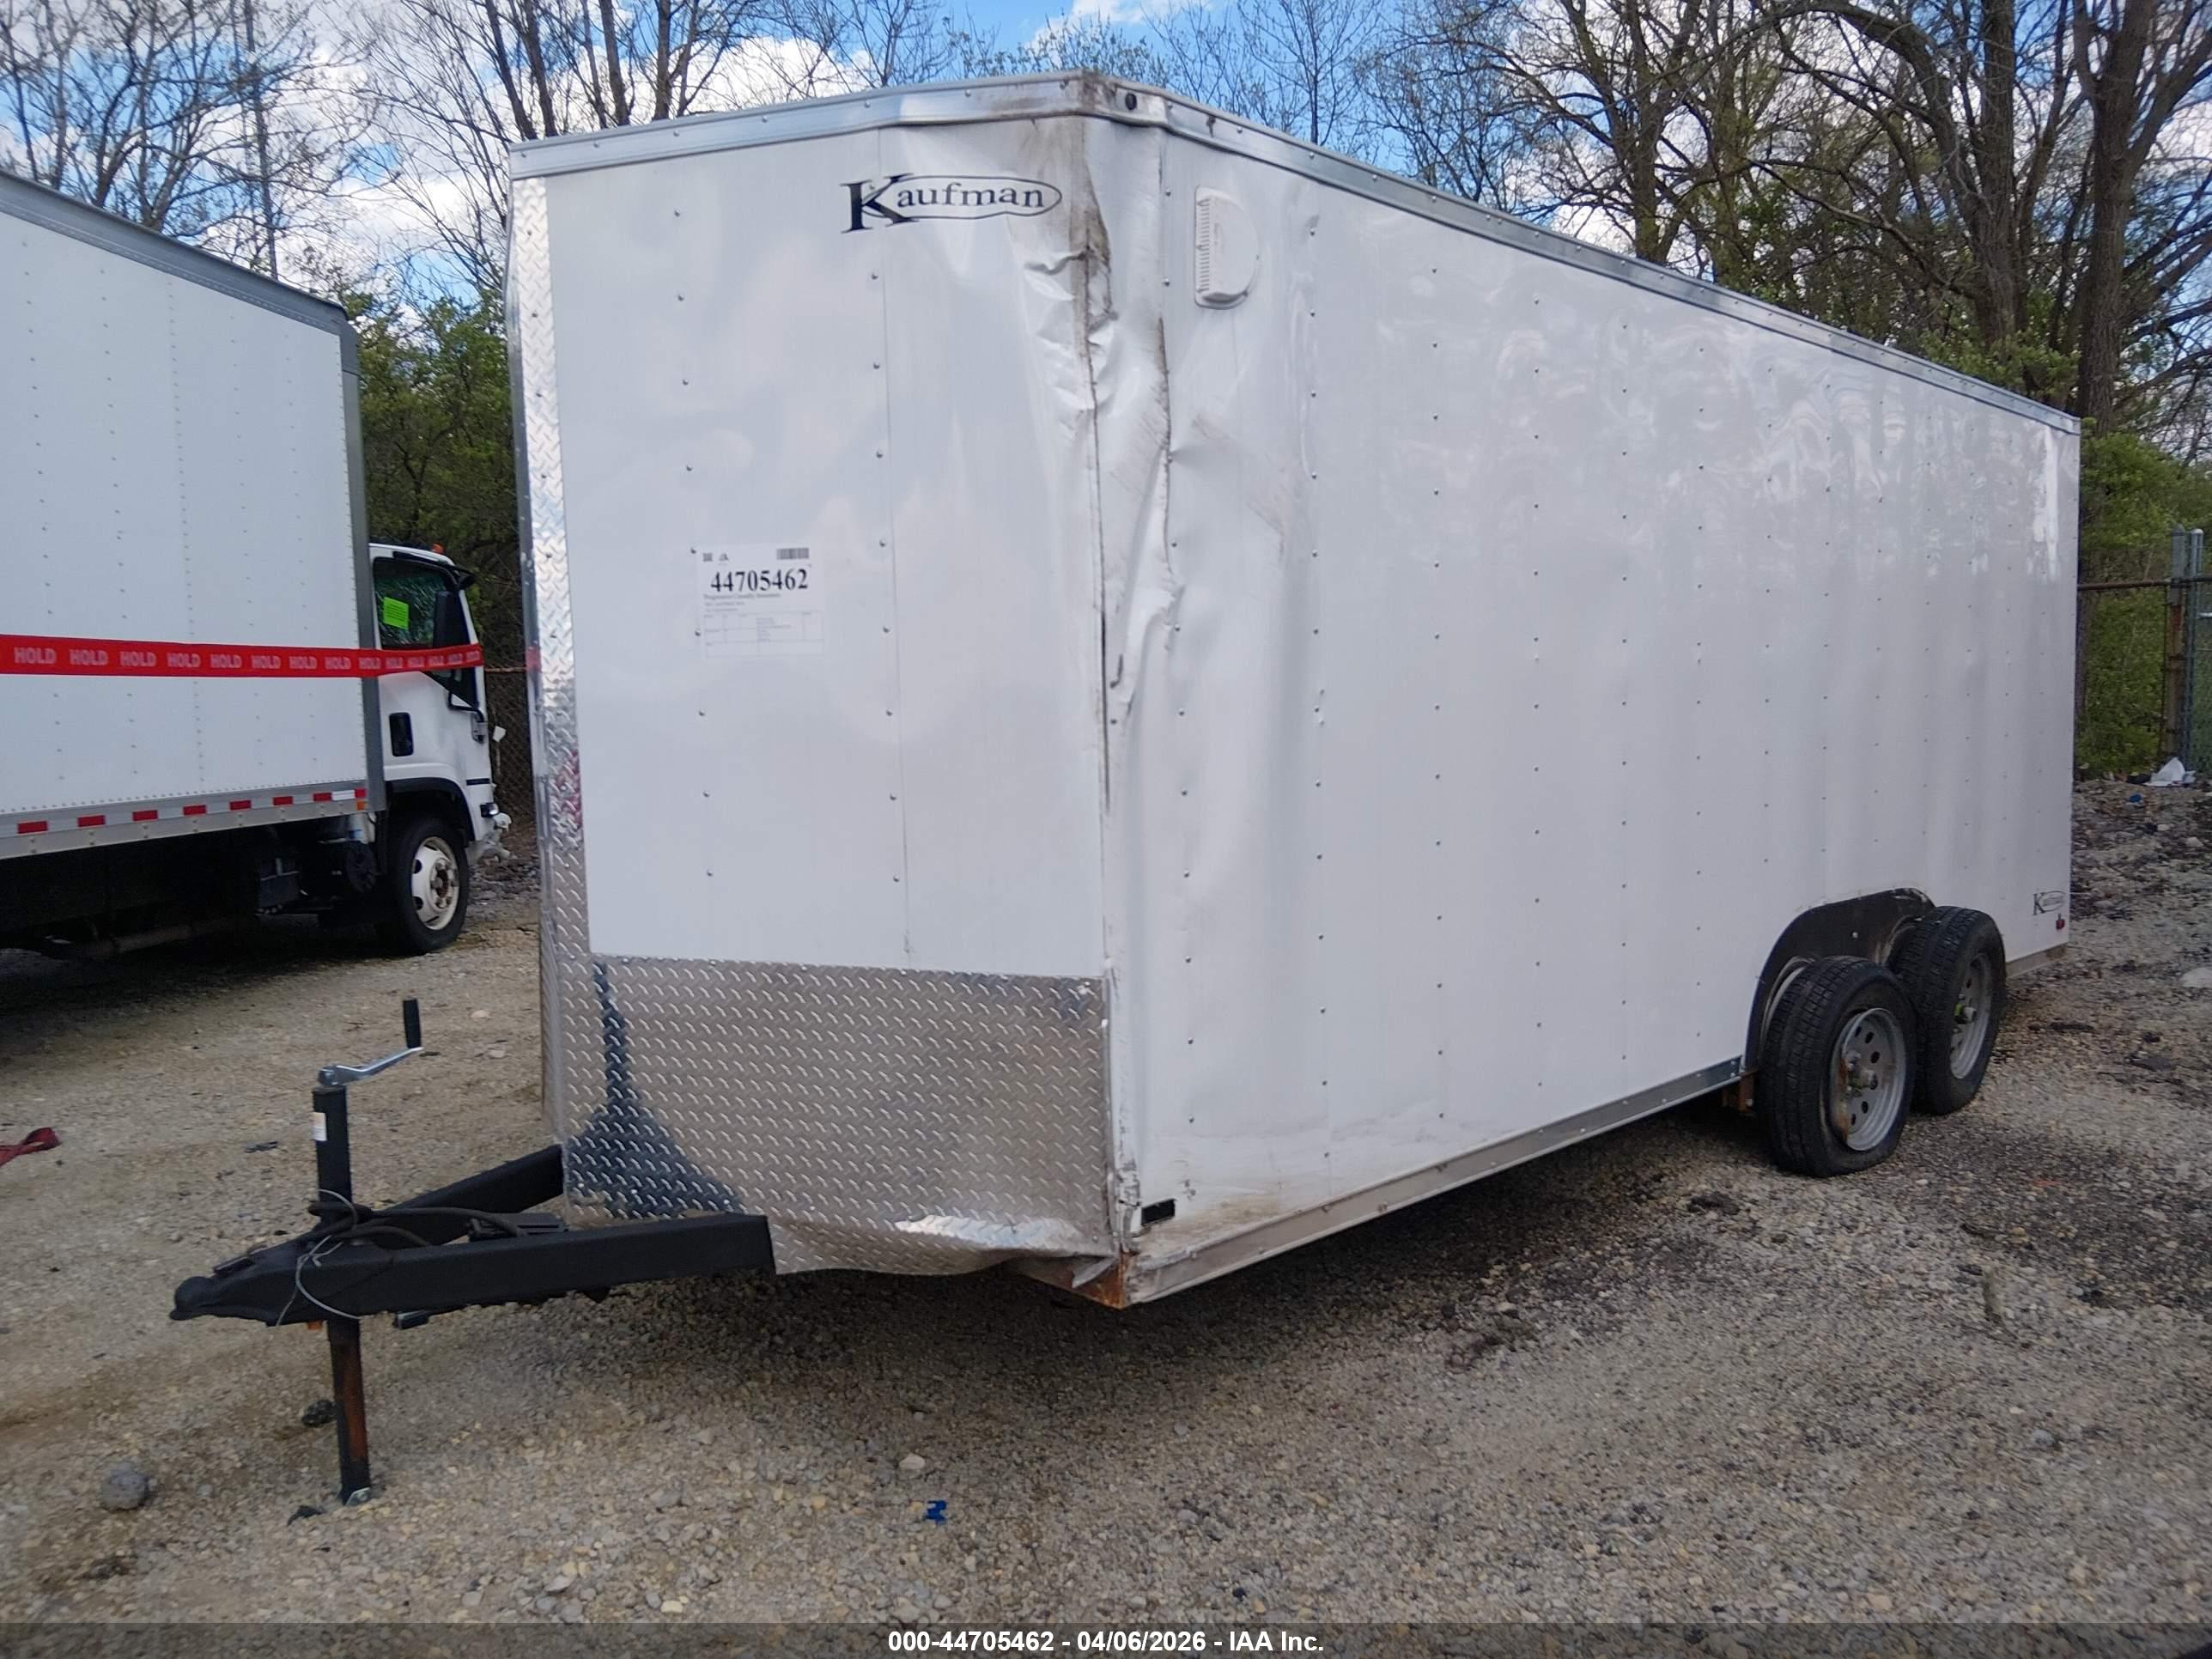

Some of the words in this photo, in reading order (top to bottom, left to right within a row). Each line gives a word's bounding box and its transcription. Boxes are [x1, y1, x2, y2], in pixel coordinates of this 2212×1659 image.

[840, 173, 1045, 234] Kaufman
[710, 568, 809, 592] 44705462
[14, 647, 57, 665] HOLD
[69, 648, 108, 666] HOLD
[119, 651, 156, 667] HOLD
[167, 653, 201, 668] HOLD
[210, 653, 242, 669] HOLD
[251, 655, 281, 669] HOLD
[289, 656, 318, 670] HOLD
